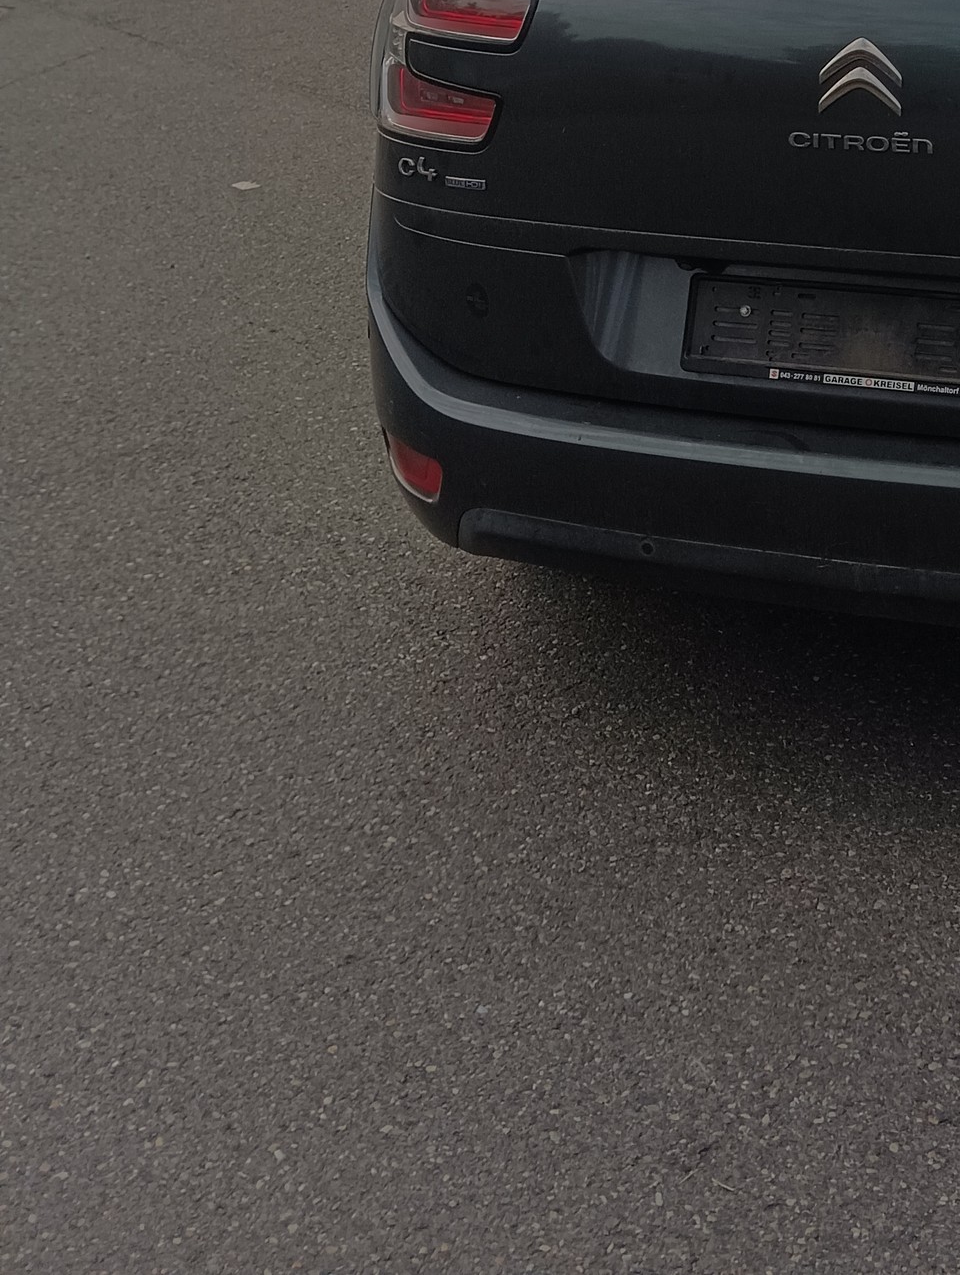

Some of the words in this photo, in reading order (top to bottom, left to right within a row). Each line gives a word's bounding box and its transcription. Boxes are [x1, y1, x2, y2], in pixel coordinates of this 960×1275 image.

[397, 156, 438, 182] C4
[824, 375, 863, 386] GARAGE
[873, 379, 914, 391] KREISEL
[917, 384, 959, 395] Mönchaltorf
